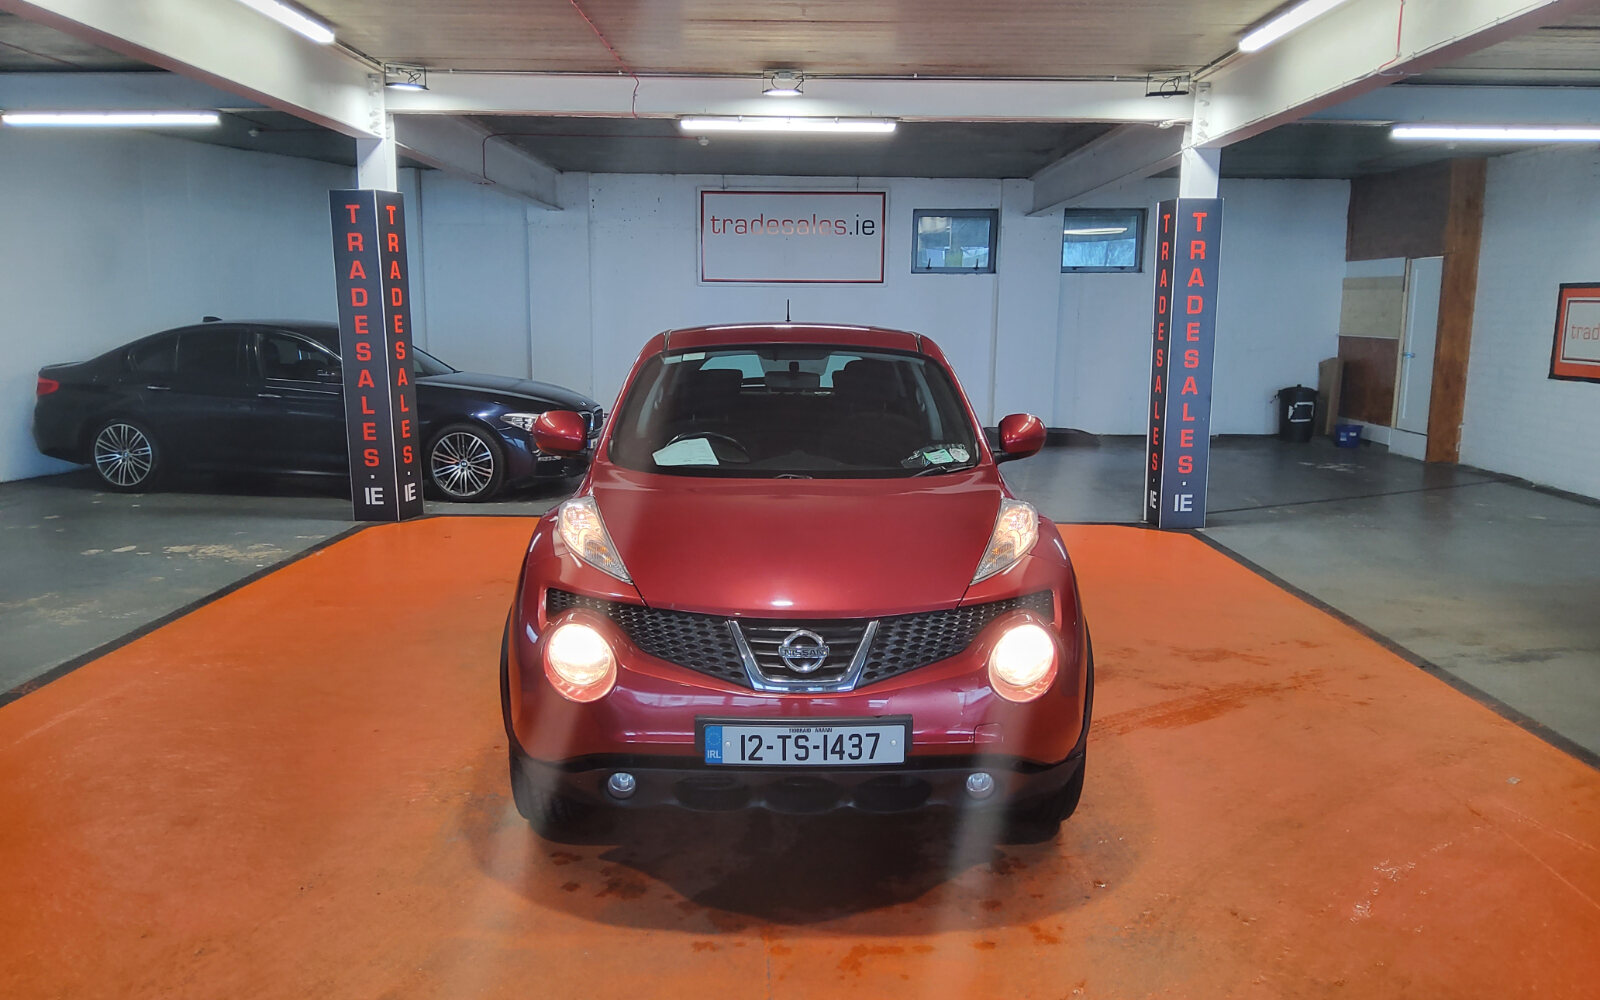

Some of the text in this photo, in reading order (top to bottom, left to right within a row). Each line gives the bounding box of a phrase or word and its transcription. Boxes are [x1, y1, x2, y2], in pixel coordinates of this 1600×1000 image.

[710, 213, 875, 235] tradesales.ie
[783, 649, 826, 657] NISSAN
[707, 750, 721, 759] IRL
[740, 733, 881, 761] 12-TS-1437
